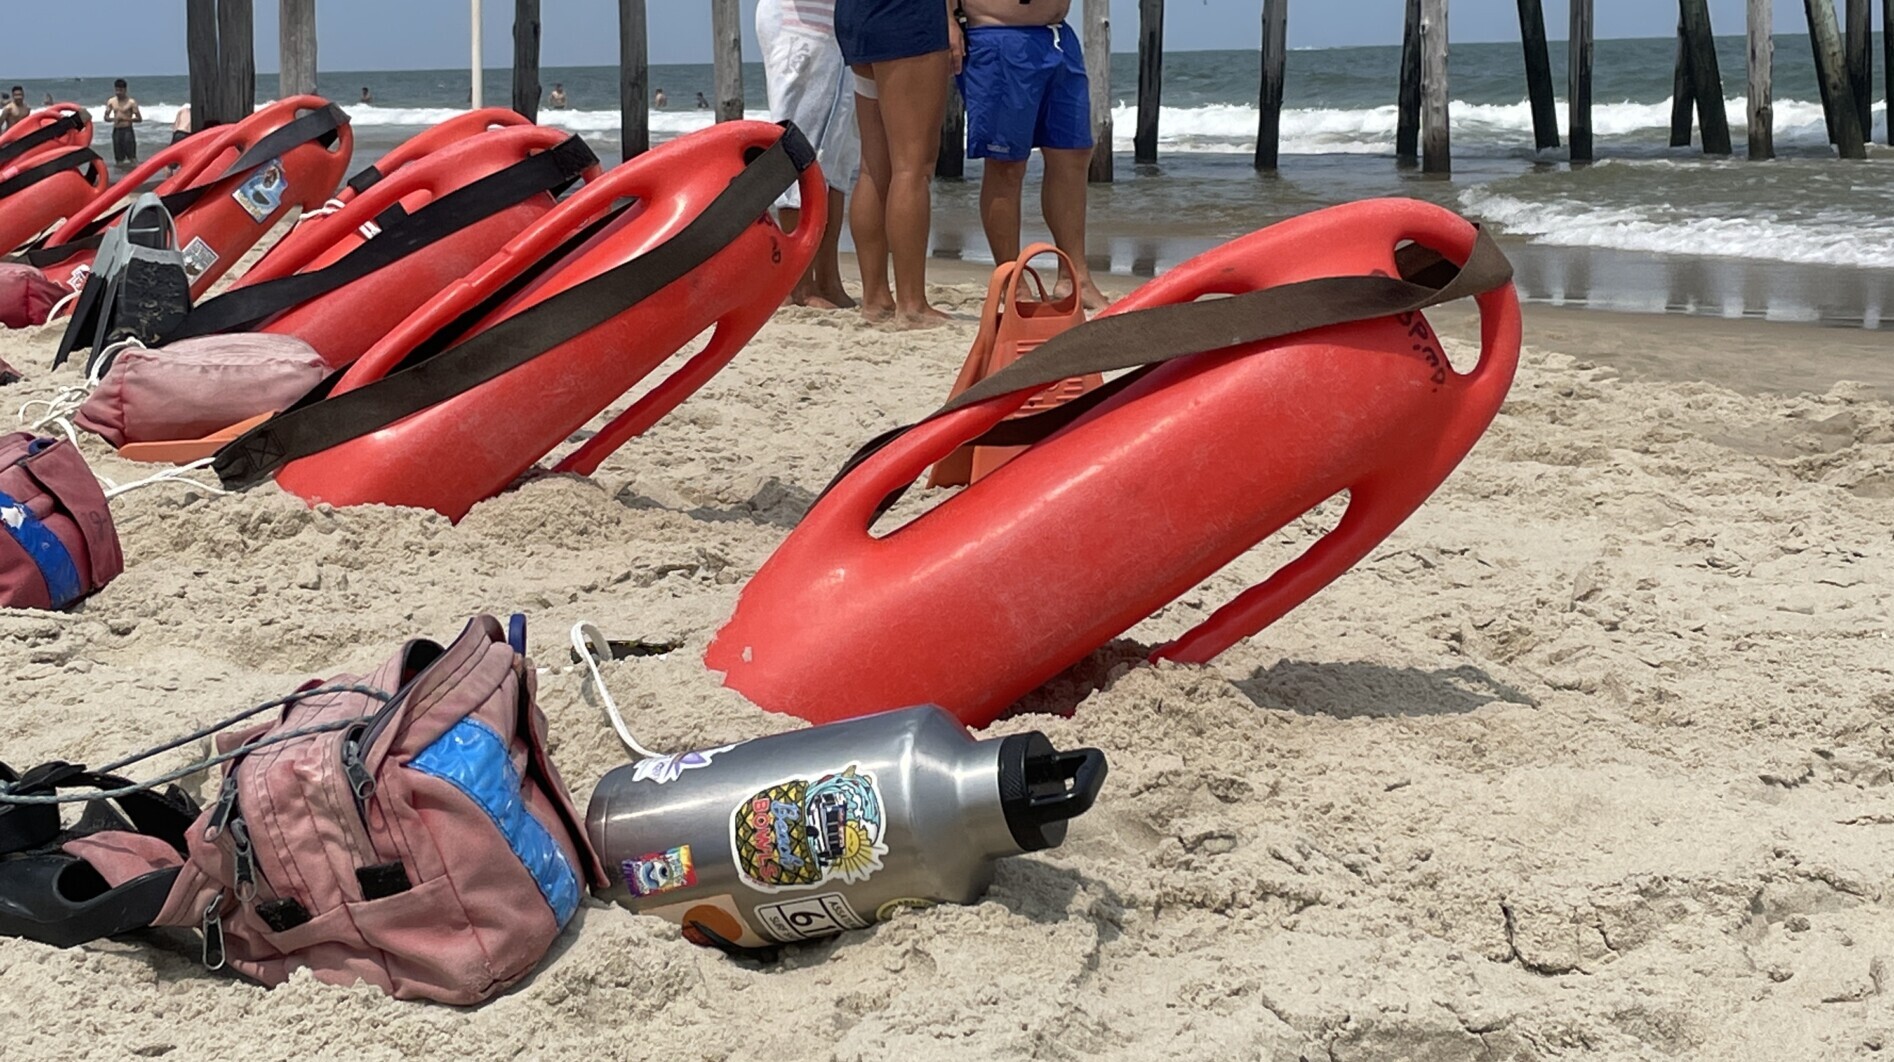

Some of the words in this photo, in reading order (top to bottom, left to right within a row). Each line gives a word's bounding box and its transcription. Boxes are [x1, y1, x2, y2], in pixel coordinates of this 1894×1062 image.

[752, 797, 782, 879] BOWLS
[770, 799, 805, 870] Beach
[789, 911, 837, 934] 61
